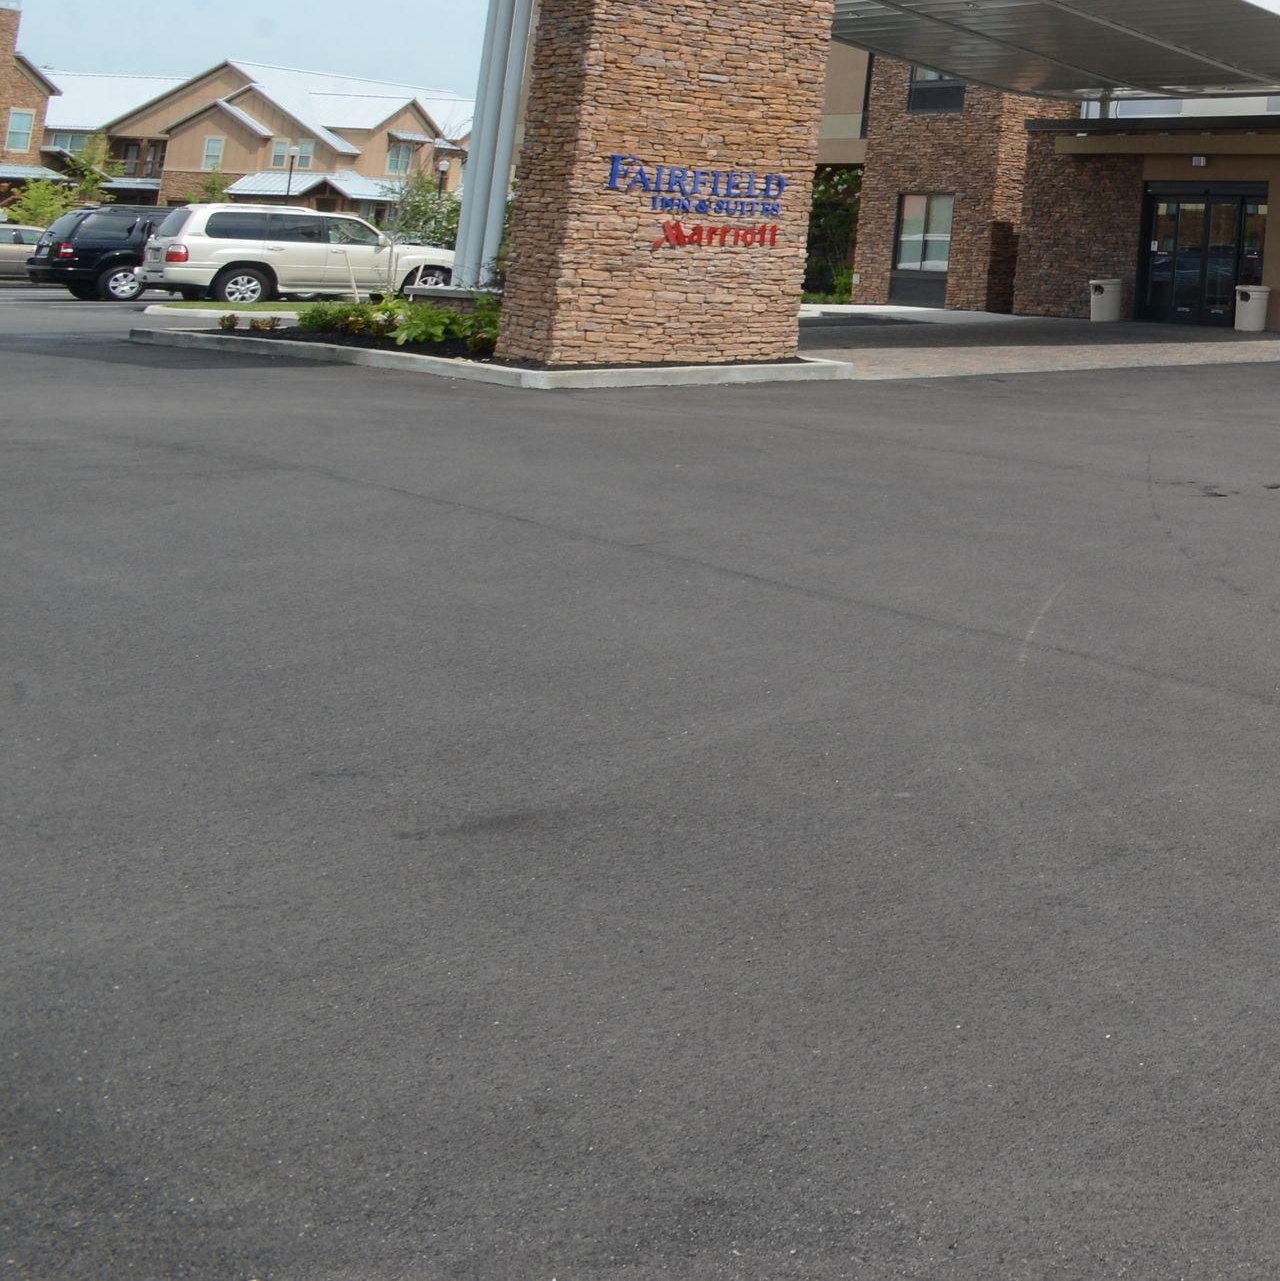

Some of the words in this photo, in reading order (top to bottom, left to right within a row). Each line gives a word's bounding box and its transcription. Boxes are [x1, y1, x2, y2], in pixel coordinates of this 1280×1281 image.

[605, 154, 788, 199] FAIRFIELD
[651, 196, 690, 213] INN
[695, 198, 709, 214] &
[714, 199, 782, 216] SUITES
[652, 220, 779, 248] Marriott
